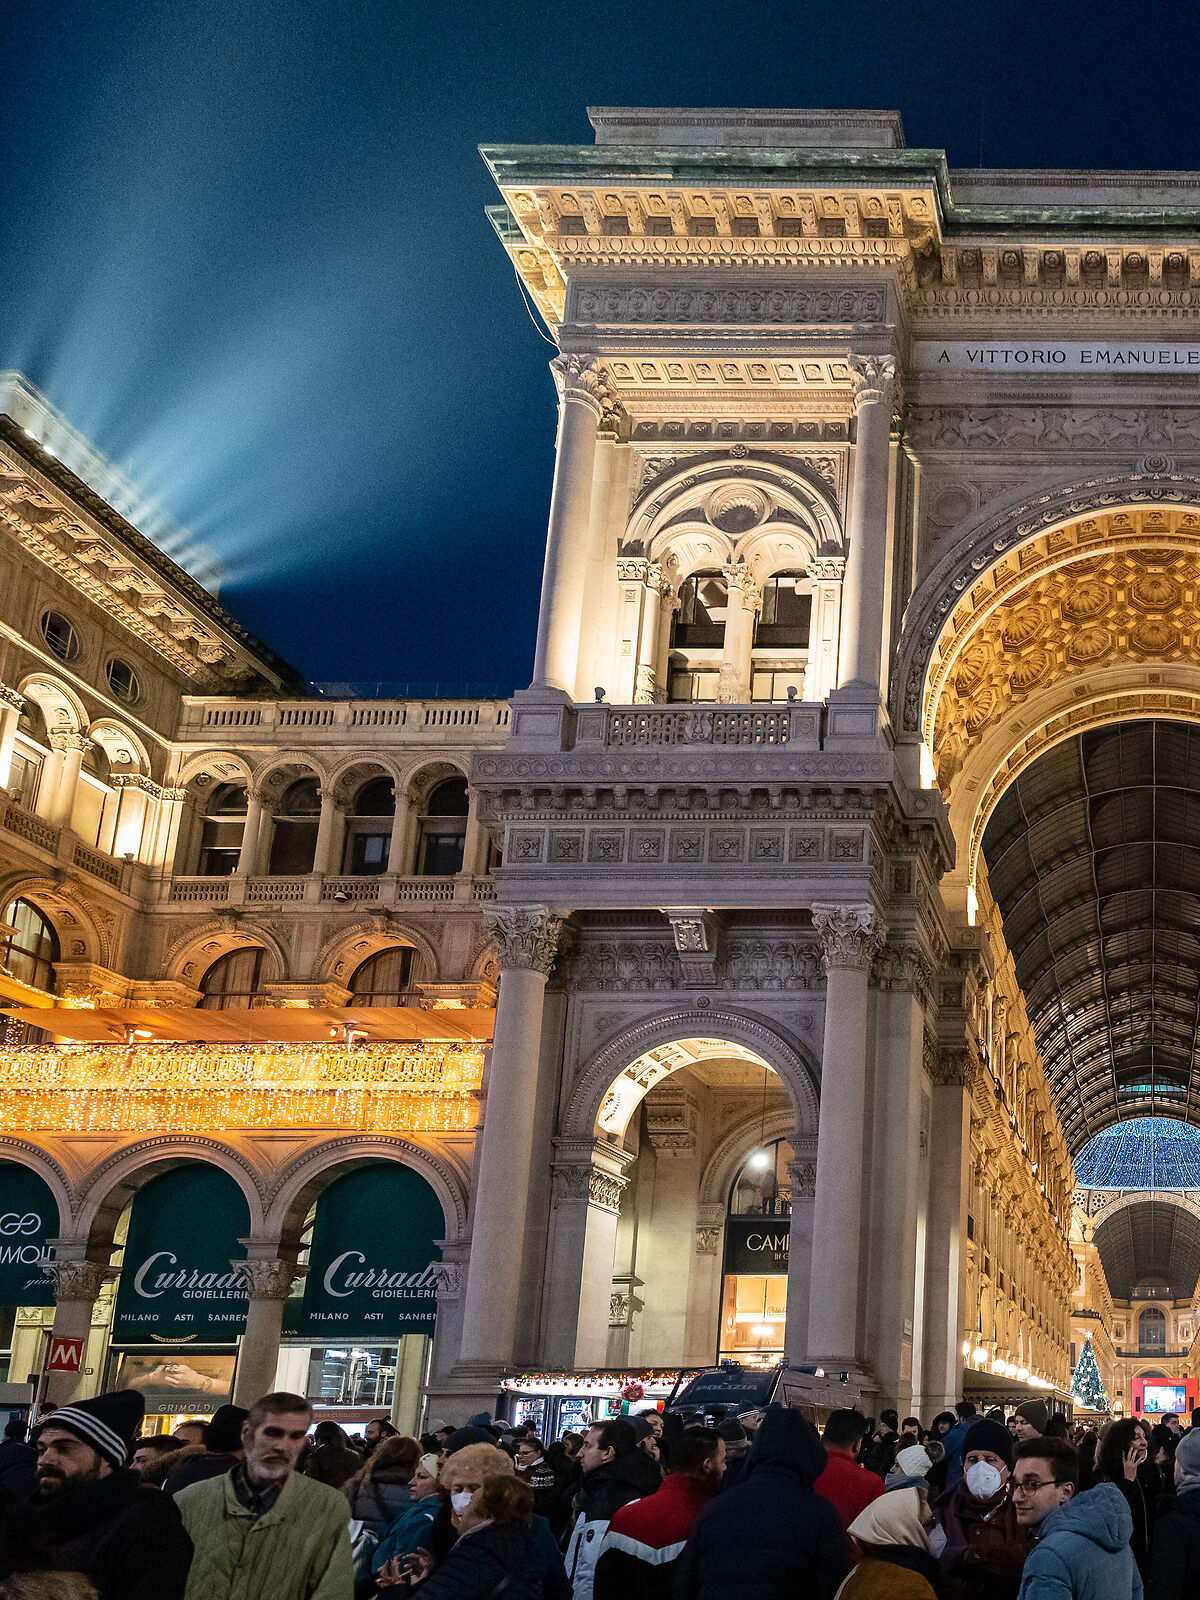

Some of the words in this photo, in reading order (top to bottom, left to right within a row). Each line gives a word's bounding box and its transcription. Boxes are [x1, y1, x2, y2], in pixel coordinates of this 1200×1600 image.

[938, 350, 951, 363] A
[966, 350, 1067, 364] VITTORIO
[1080, 351, 1200, 365] EMANUELE
[309, 1312, 349, 1320] MILANO
[52, 1345, 78, 1365] M
[158, 1403, 216, 1413] GRIMOLDI
